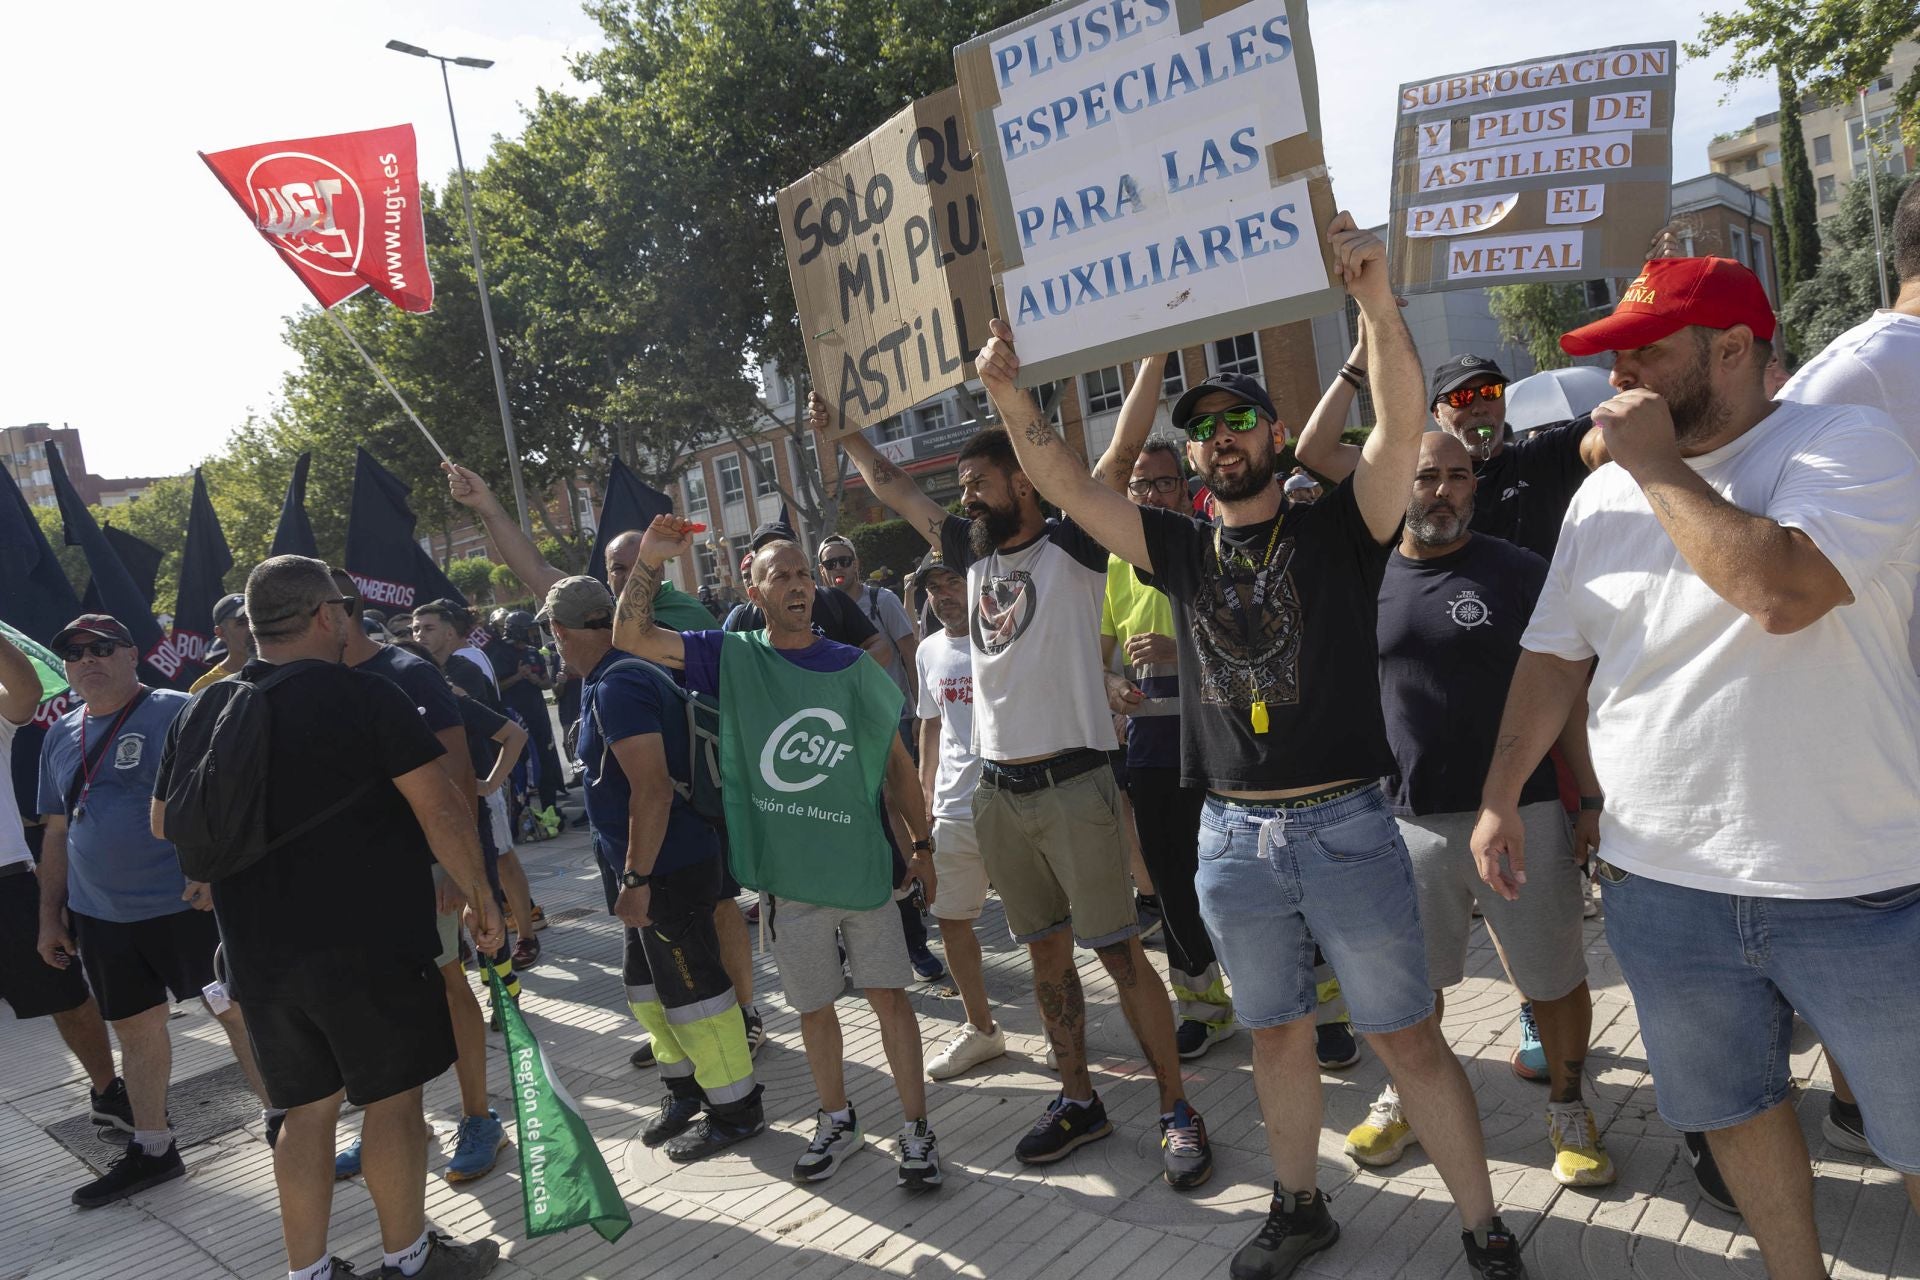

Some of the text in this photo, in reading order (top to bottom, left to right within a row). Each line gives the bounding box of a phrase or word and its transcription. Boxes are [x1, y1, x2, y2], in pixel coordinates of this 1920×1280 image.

[994, 0, 1172, 89] PLUSES
[1402, 50, 1666, 110] SUBROGACION
[1000, 14, 1293, 161] ESPECIALES
[1424, 123, 1446, 147] Y
[1477, 106, 1567, 140] PLUS
[1595, 95, 1647, 121] DE
[1017, 126, 1260, 249] PARA LAS
[1424, 142, 1631, 188] ASTILLERO
[257, 178, 342, 235] UGT
[379, 152, 407, 290] www.ugt.es
[794, 172, 894, 266] SOLO
[905, 193, 987, 285] PLU
[1415, 188, 1596, 232] PARA EL
[1016, 203, 1300, 327] AUXILIARES
[1452, 243, 1581, 274] METAL
[780, 731, 854, 768] CSIF
[787, 802, 804, 816] de
[807, 805, 852, 824] Murcia
[518, 1047, 551, 1216] Región de Murcia
